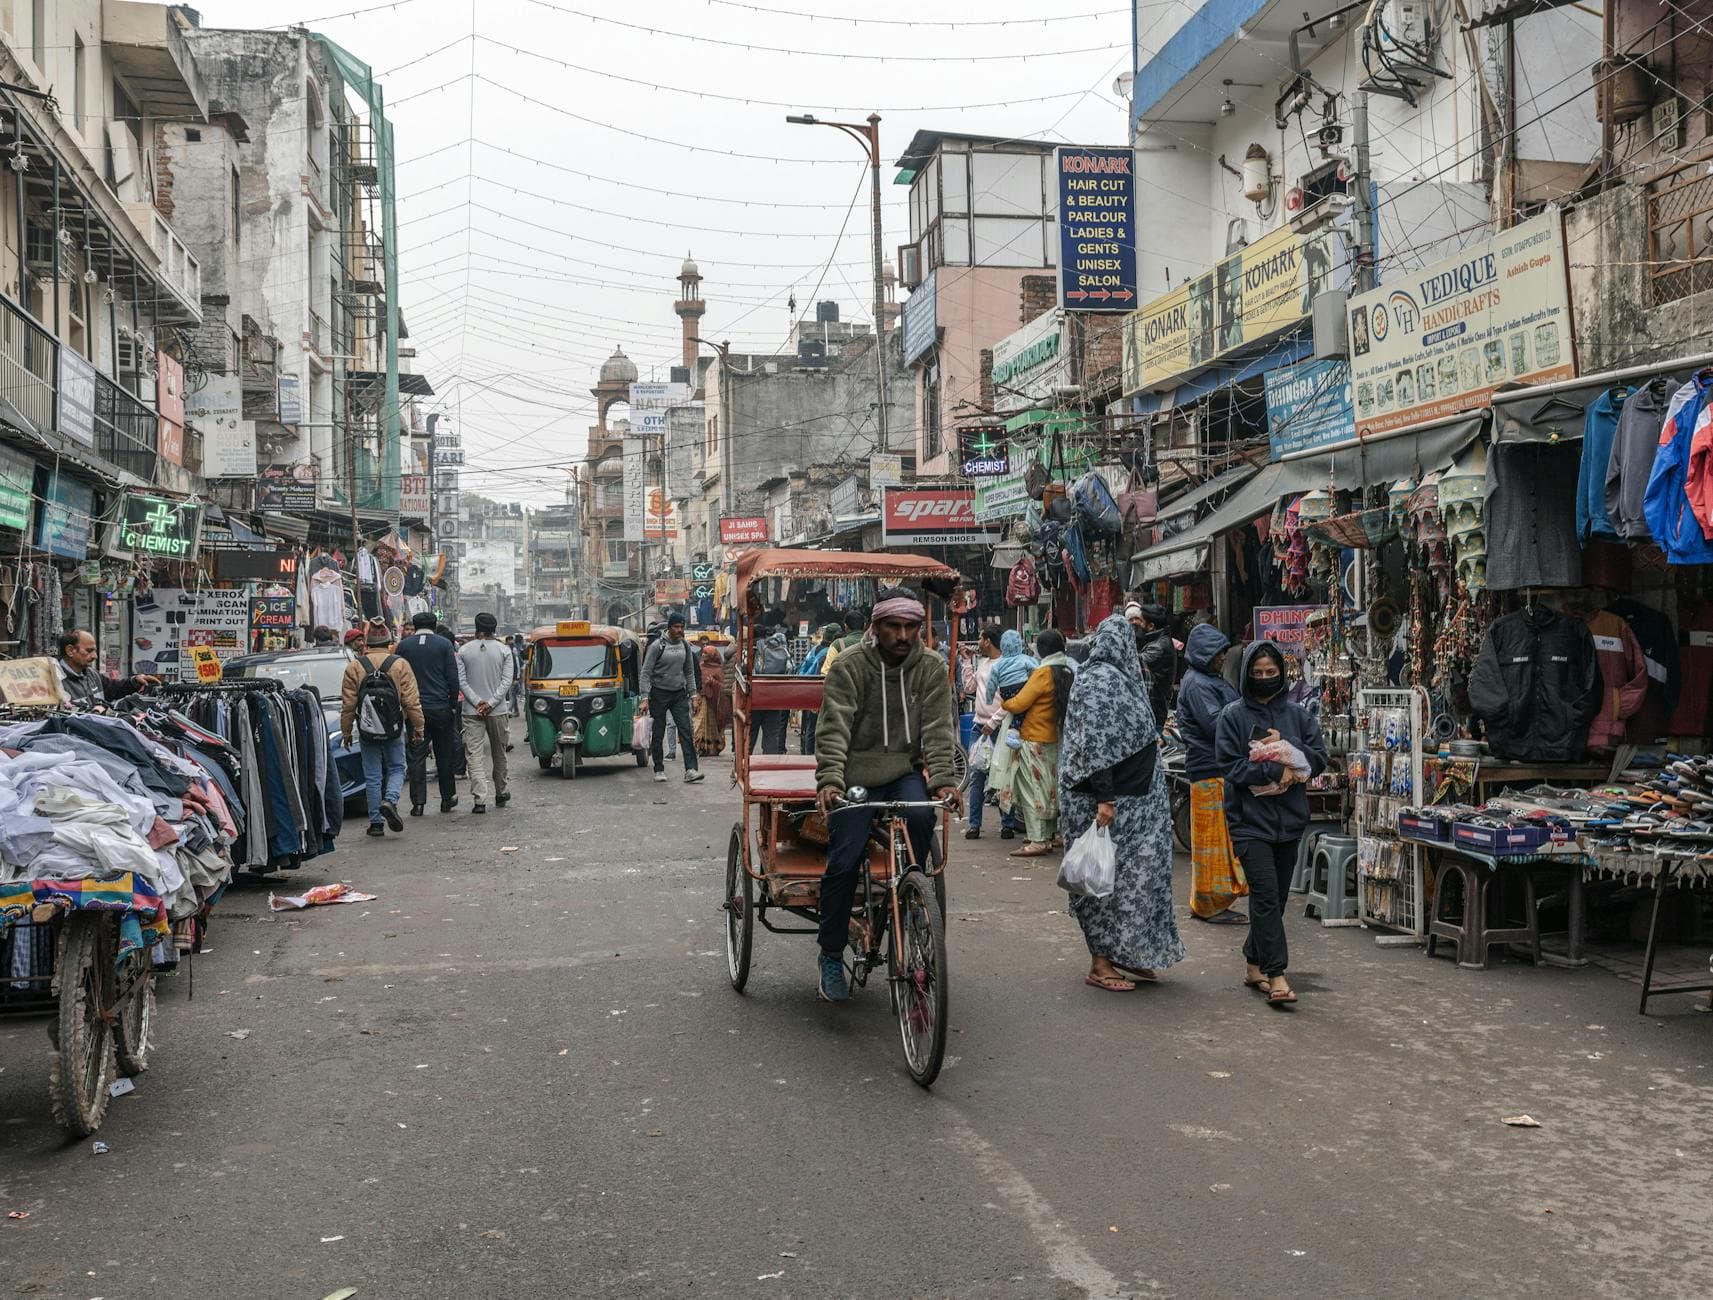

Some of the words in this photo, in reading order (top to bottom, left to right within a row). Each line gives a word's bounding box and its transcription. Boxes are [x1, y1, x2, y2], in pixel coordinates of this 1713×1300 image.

[1062, 155, 1130, 174] KONARK
[1068, 179, 1098, 191] HAIR
[1100, 180, 1125, 191] CUT
[1066, 195, 1076, 206] &
[1078, 196, 1128, 207] BEAUTY
[1068, 211, 1127, 223] PARLOUR
[1070, 228, 1114, 238] LADIES
[1117, 228, 1126, 239] &
[1077, 243, 1119, 255] GENTS
[1076, 259, 1121, 270] UNISEX
[1245, 244, 1296, 293] KONARK
[1078, 275, 1121, 286] SALON
[1420, 253, 1497, 305] VEDIQUE
[1423, 288, 1501, 331] HANDICRAFTS
[1145, 304, 1187, 345] KONARK
[1268, 377, 1315, 409] DHINGRA
[965, 460, 1006, 473] CHEMIST
[724, 532, 749, 540] UNISEX
[751, 531, 764, 539] SPA
[913, 536, 948, 544] REMSON
[949, 535, 976, 543] SHOES
[207, 590, 245, 599] XEROX
[216, 600, 247, 608] SCAN
[270, 602, 287, 612] ICE
[188, 608, 248, 616] LAMINATION
[259, 615, 292, 625] CREAM
